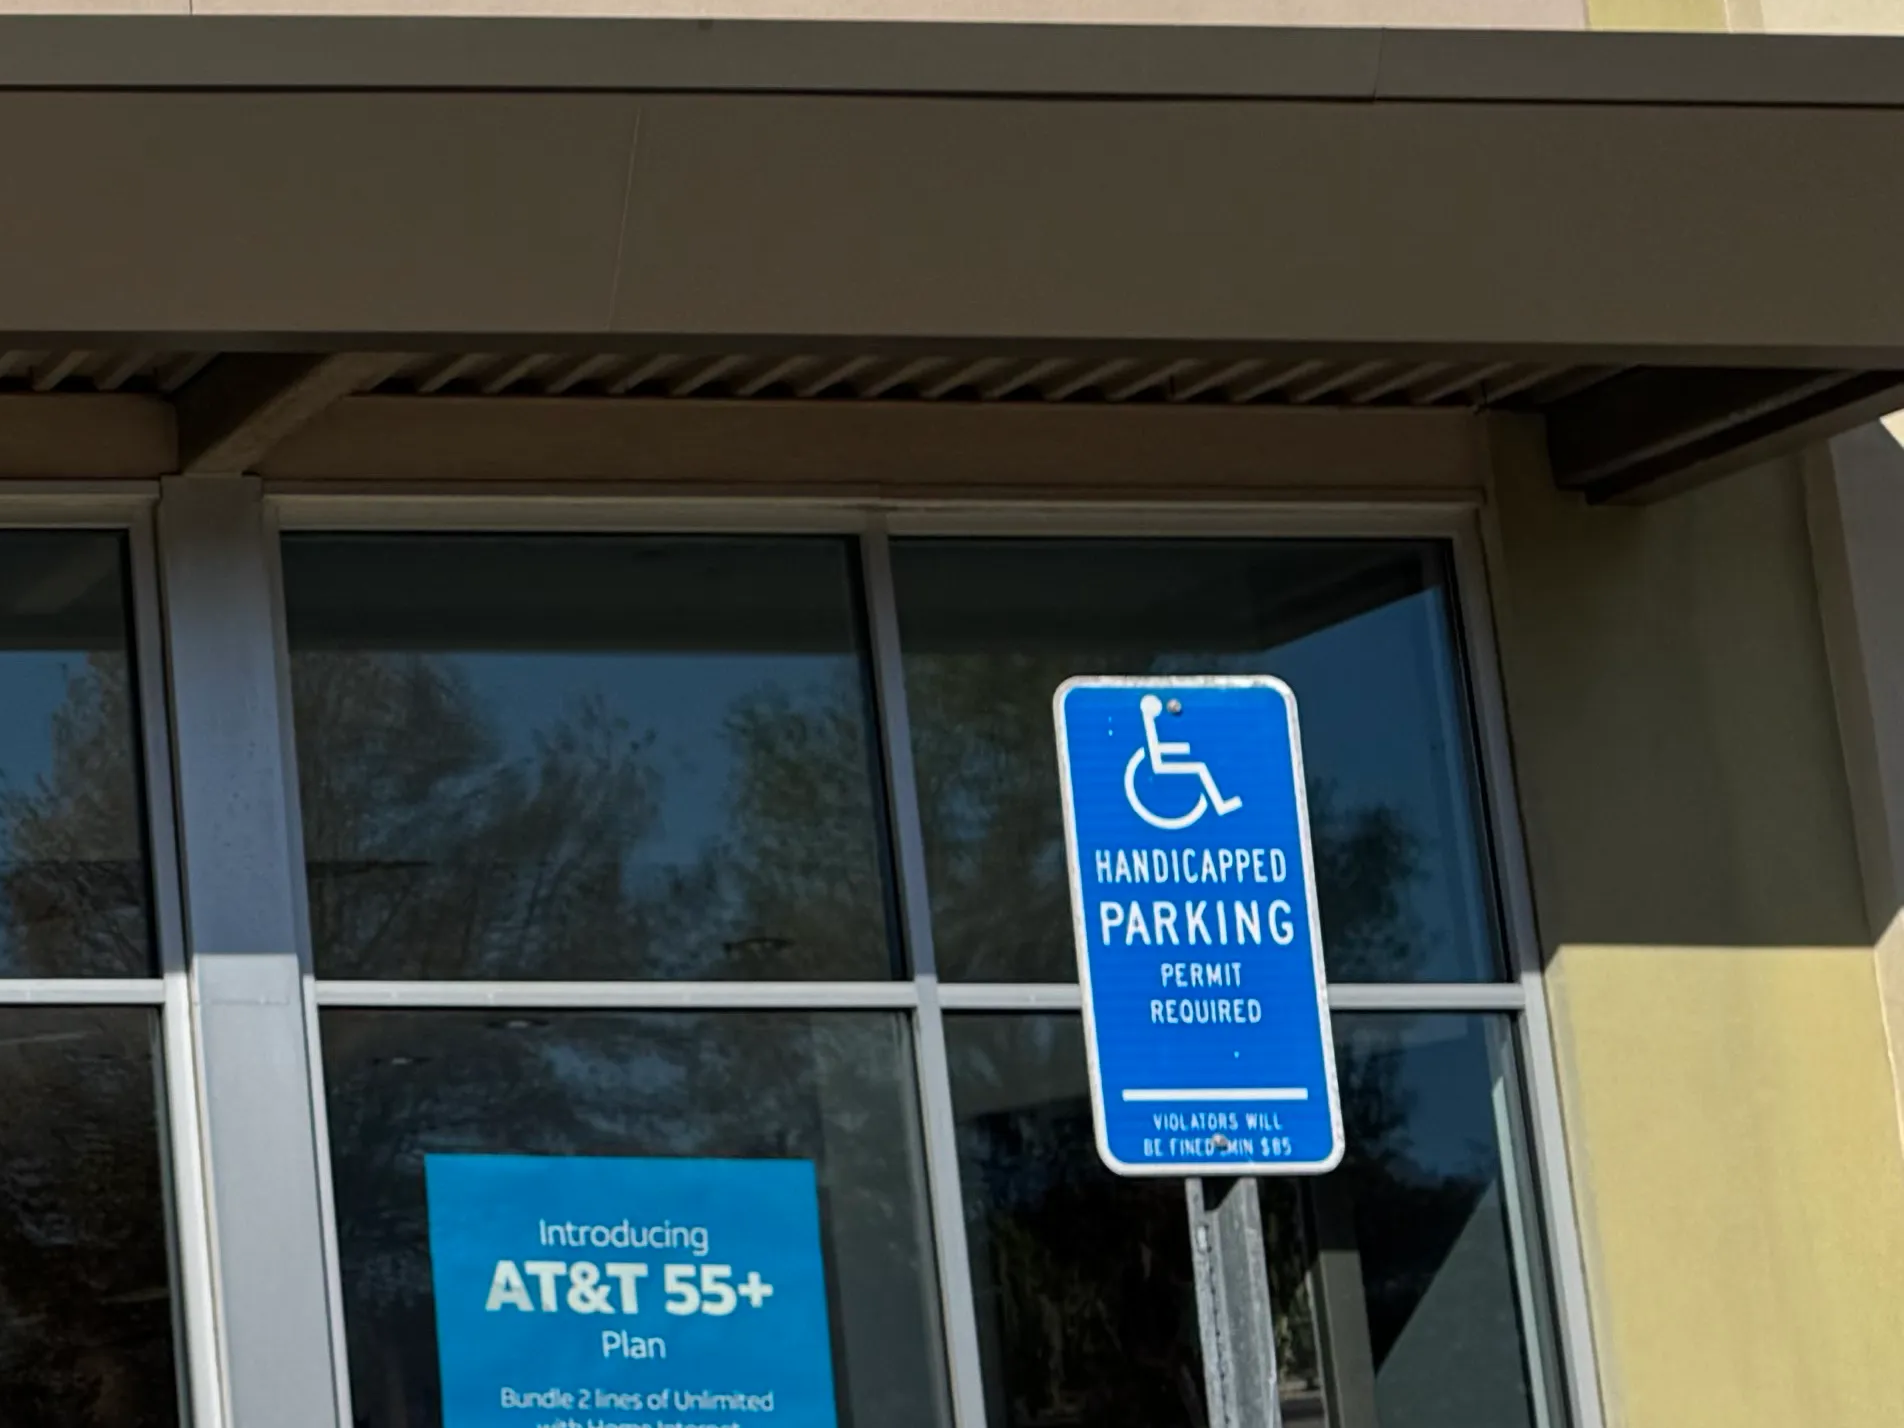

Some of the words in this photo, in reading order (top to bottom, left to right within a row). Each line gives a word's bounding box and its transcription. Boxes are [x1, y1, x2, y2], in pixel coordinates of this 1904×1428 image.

[1095, 847, 1287, 884] HANDICAPPED
[1100, 899, 1294, 946] PARKING
[1160, 963, 1242, 988] PERMIT
[1150, 998, 1262, 1024] REQUIRED
[1153, 1113, 1239, 1131] VIOLATORS
[1245, 1113, 1283, 1130] WILL
[1144, 1138, 1164, 1157] BE
[1260, 1137, 1292, 1157] $85
[539, 1219, 709, 1256] Introducing
[485, 1260, 648, 1314] AT&T
[663, 1264, 774, 1316] 55+
[601, 1331, 666, 1360] Plan
[501, 1387, 574, 1409] Bundle
[579, 1389, 591, 1409] 2
[595, 1389, 643, 1410] lines
[647, 1389, 669, 1410] of
[673, 1390, 774, 1412] Unlimited
